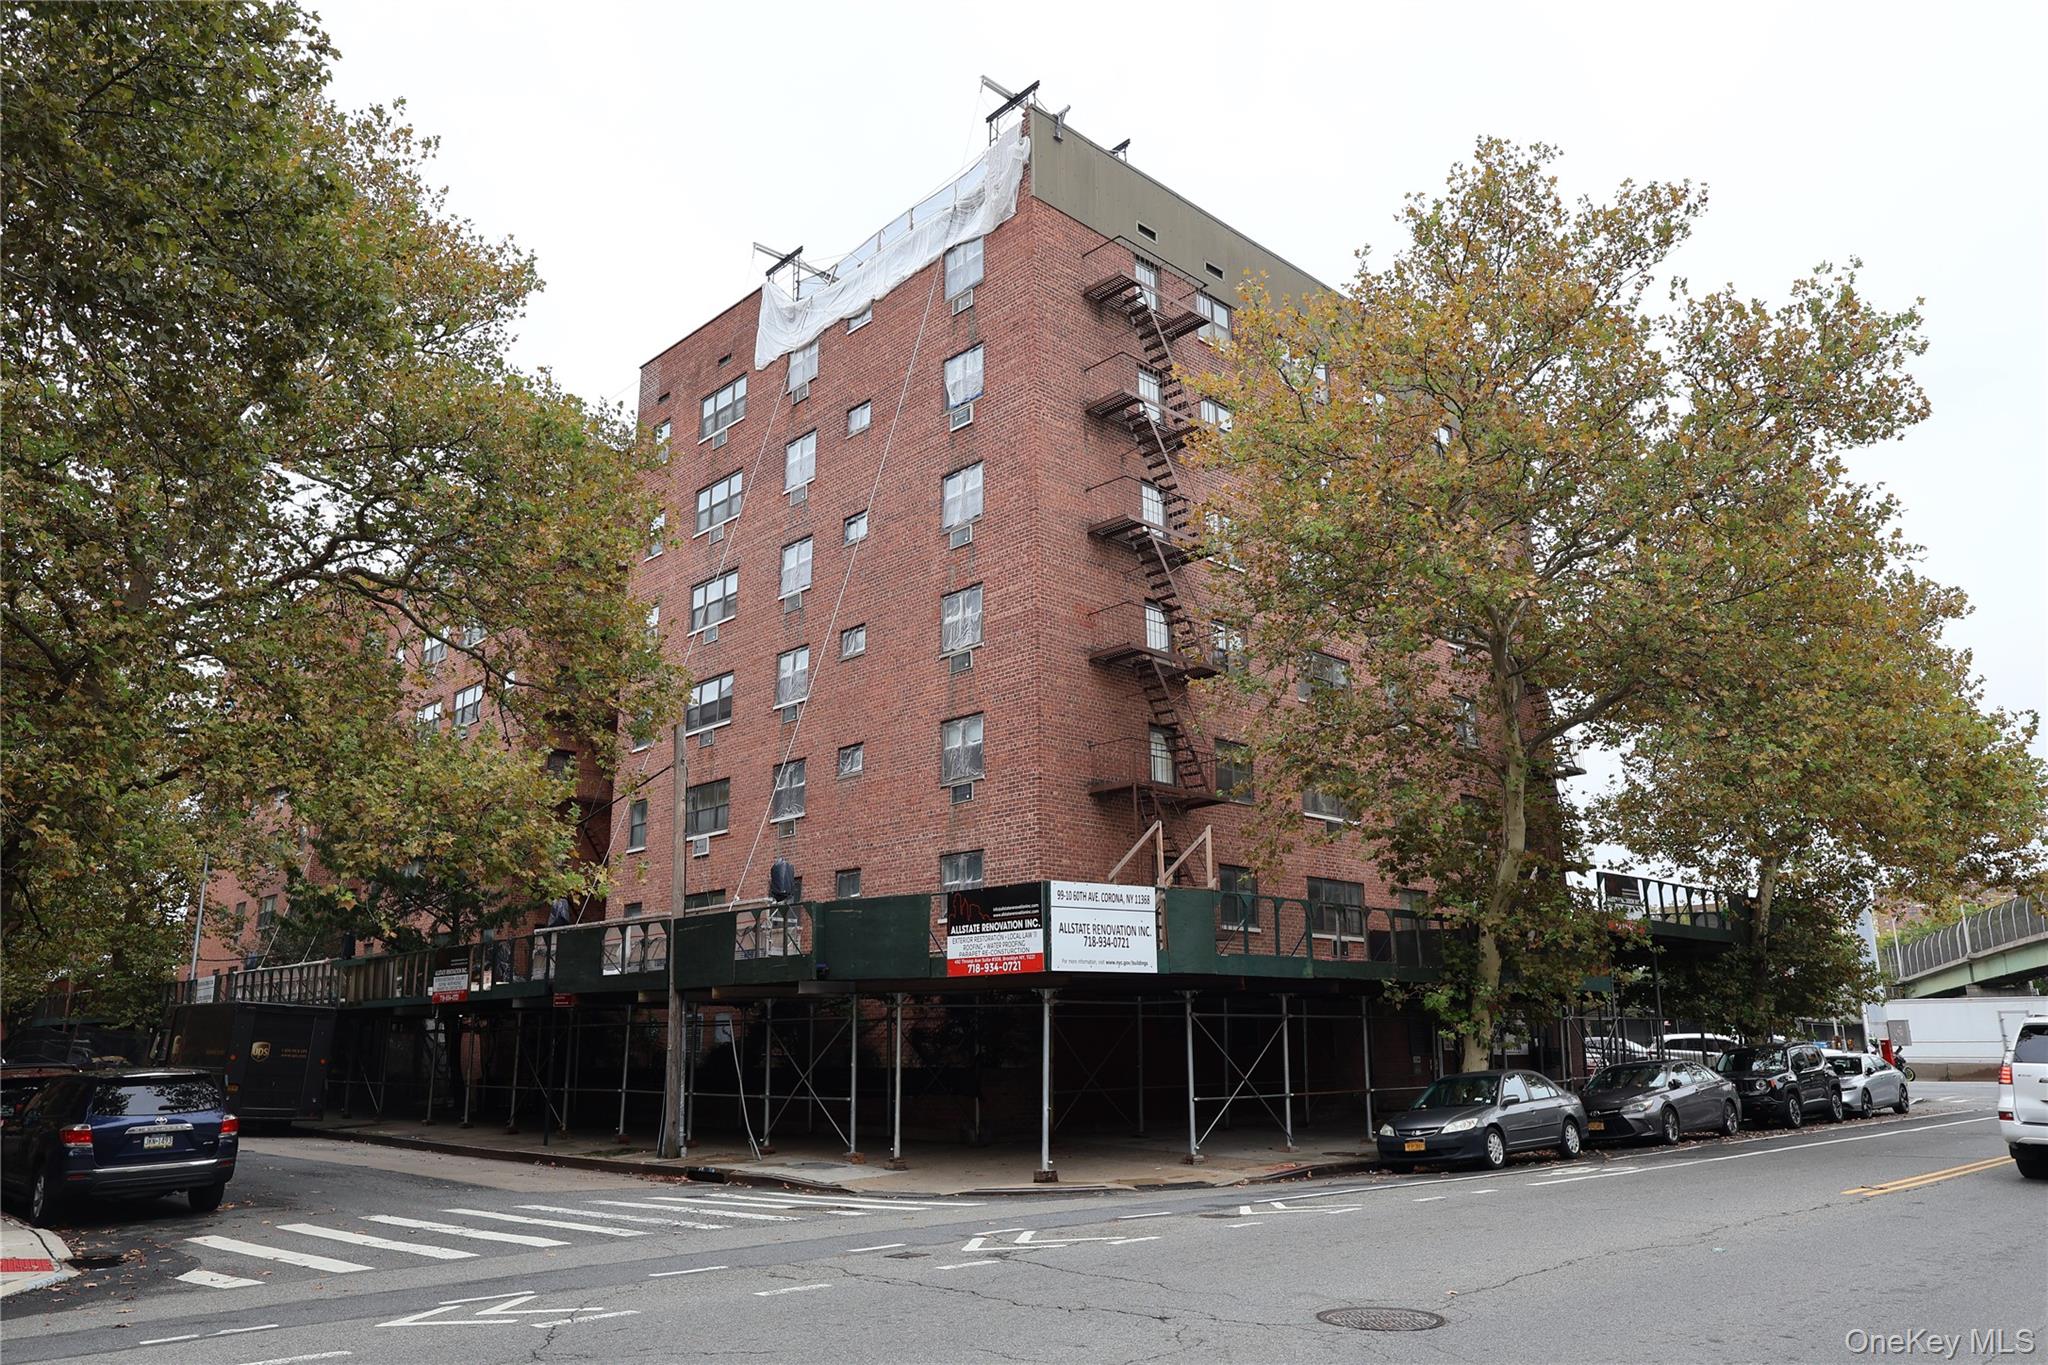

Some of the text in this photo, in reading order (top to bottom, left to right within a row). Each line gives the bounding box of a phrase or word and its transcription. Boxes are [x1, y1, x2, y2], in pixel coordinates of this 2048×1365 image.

[1056, 890, 1073, 901] 99-10
[1073, 891, 1087, 902] 60TH
[1126, 894, 1134, 904] NY
[1134, 894, 1150, 905] 11368
[950, 918, 1041, 935] ALLSTATE RENOVATION INC.
[1058, 922, 1152, 937] ALLSTATE RENOVATION INC.
[952, 936, 974, 945] EXTERIOR
[974, 933, 1005, 943] RESTORATION
[1007, 932, 1022, 941] LOCAL
[1083, 936, 1130, 949] 718-934-0721
[962, 940, 1026, 951] ROOFING WATER PROOFING
[958, 949, 981, 957] PARAPET
[967, 960, 1021, 974] 718-934-0721
